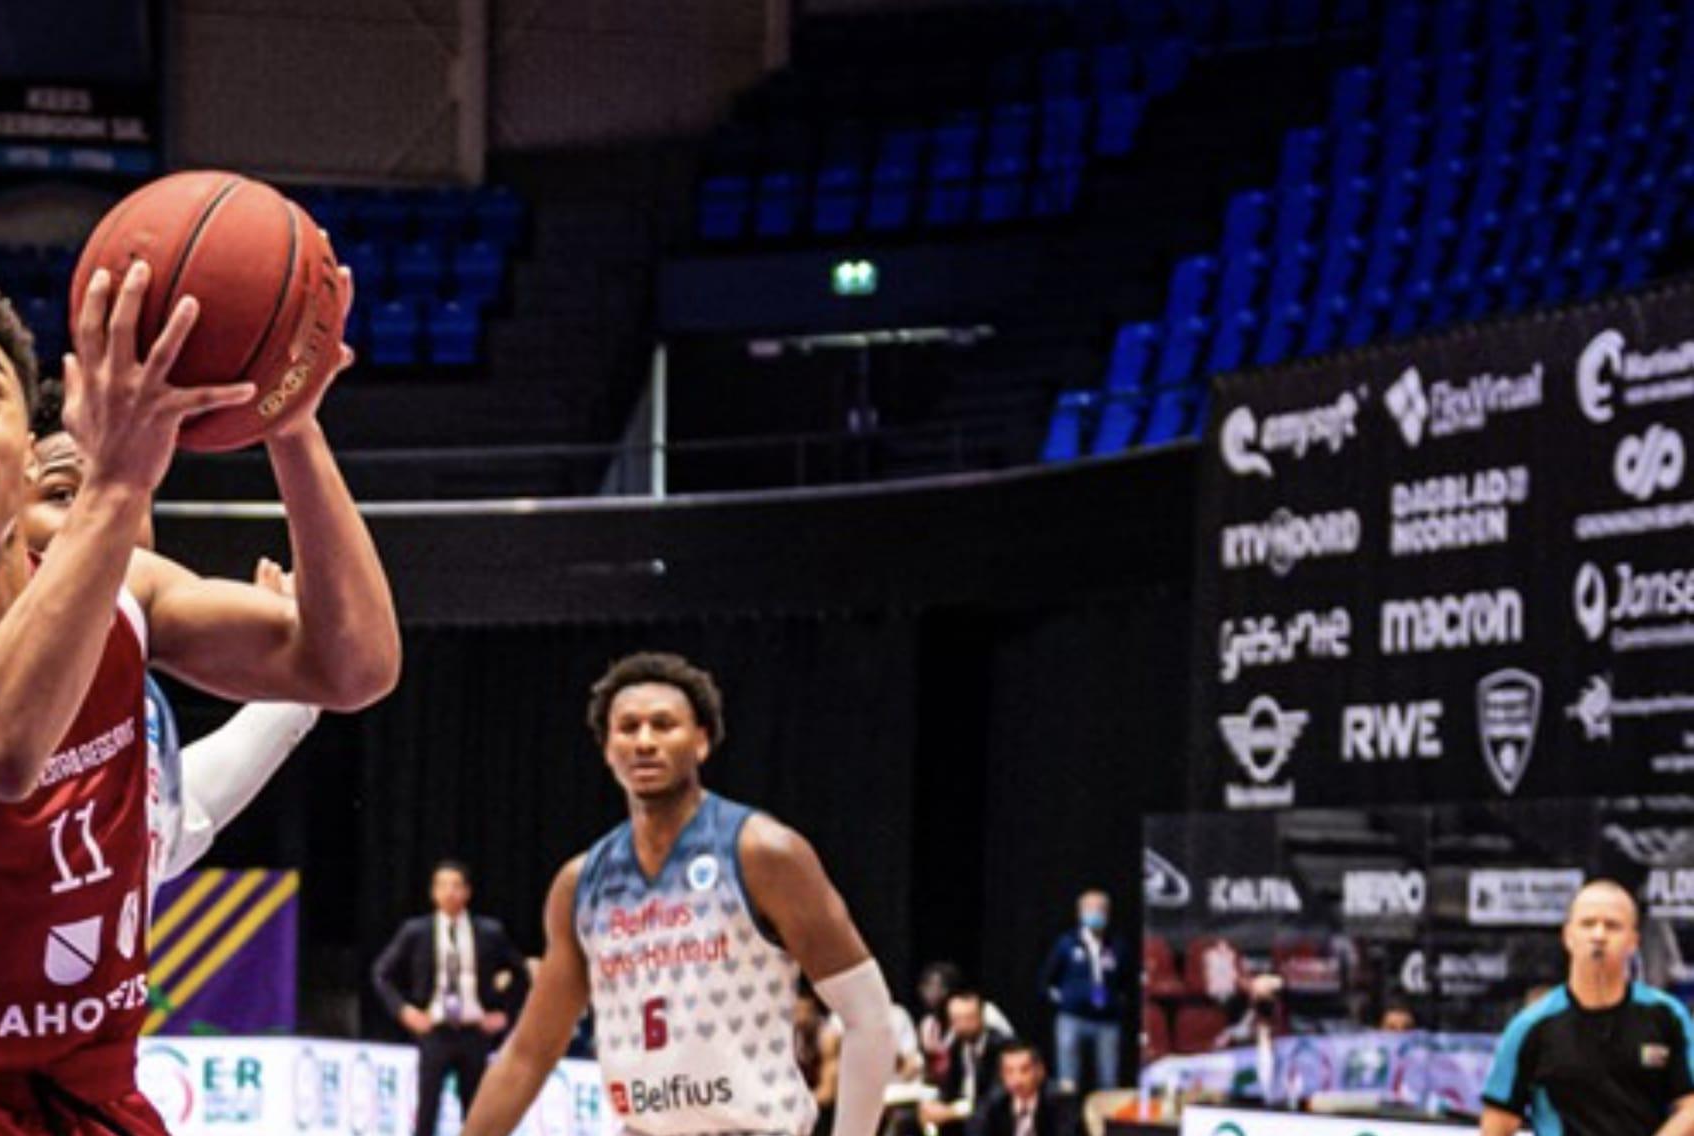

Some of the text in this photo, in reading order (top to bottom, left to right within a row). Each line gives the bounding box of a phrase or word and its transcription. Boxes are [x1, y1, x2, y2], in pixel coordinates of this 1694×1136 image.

[1380, 587, 1523, 655] macron
[1341, 699, 1444, 762] RWE
[48, 797, 114, 894] 11
[641, 996, 670, 1053] 6
[629, 1073, 734, 1115] Belfius
